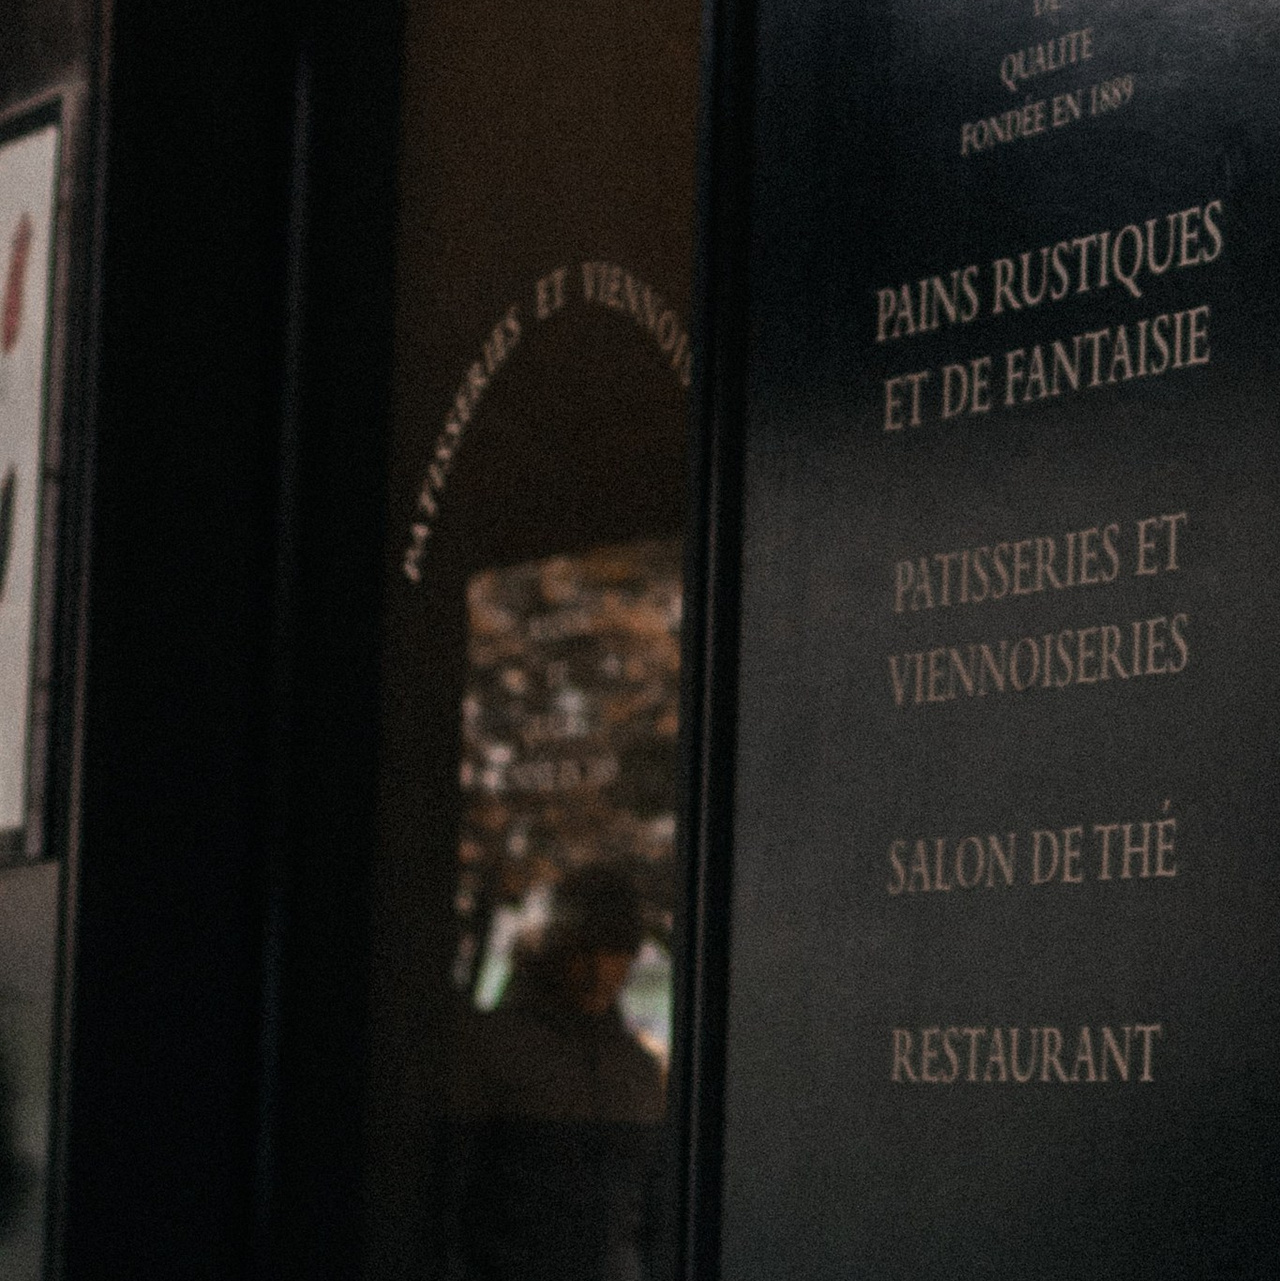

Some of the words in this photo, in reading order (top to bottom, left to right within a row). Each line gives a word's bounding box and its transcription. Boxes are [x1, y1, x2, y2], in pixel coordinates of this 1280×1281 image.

[1052, 88, 1083, 127] EN
[875, 264, 980, 343] PAINS
[992, 200, 1223, 313] RUSTIQUES
[882, 371, 929, 431] ET
[941, 356, 992, 419] DE
[1004, 305, 1212, 406] FANTAISIE
[894, 523, 1121, 614] PATISSERIES
[1134, 513, 1189, 577] ET
[888, 613, 1190, 707] VIENNOISERIES
[888, 831, 1017, 895] SALON
[1030, 824, 1083, 885] DE
[1093, 799, 1178, 881] THÉ
[890, 1022, 1163, 1083] RESTAURANT
